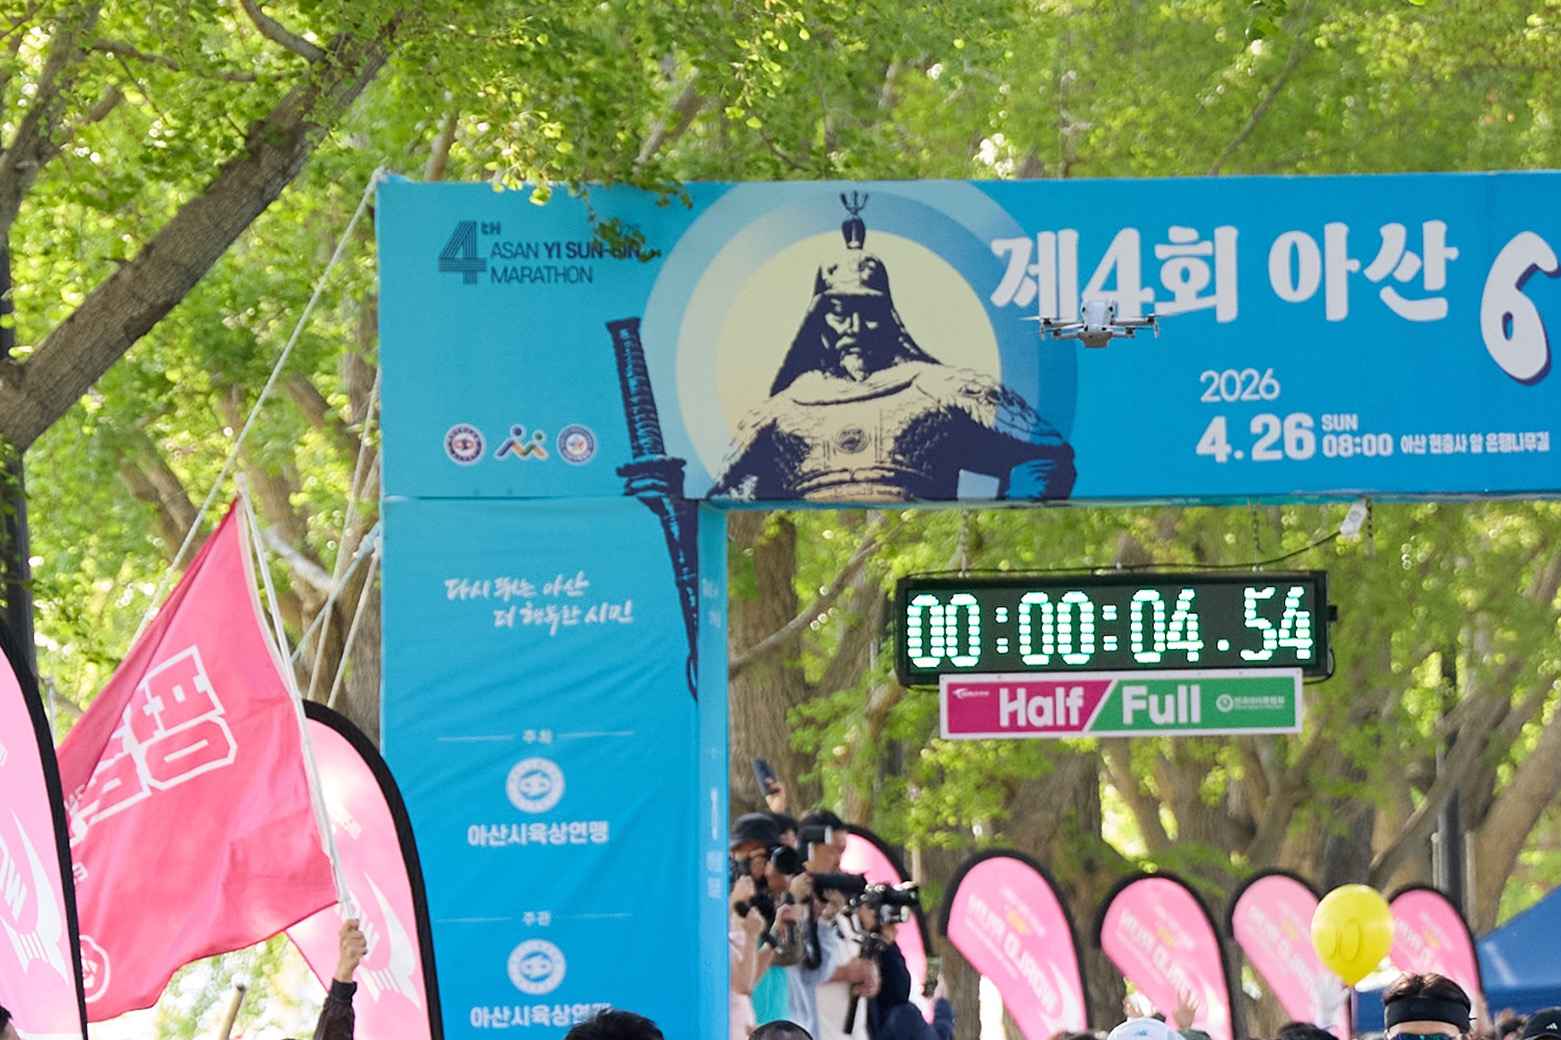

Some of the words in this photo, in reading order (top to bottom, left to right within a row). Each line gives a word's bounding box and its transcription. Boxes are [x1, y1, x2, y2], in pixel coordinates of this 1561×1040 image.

[490, 241, 539, 260] ASAN
[544, 241, 561, 259] YI
[490, 265, 594, 285] MARATHON
[991, 224, 1240, 324] 제4회
[1268, 219, 1460, 322] 아산
[1200, 368, 1281, 402] 2026
[1321, 414, 1359, 432] SUN
[1195, 412, 1315, 463] 4.26
[1322, 433, 1393, 458] 08:00
[584, 600, 633, 624] 시민
[999, 687, 1085, 728] Half
[1121, 685, 1201, 726] Full
[467, 820, 609, 846] 아산시육상연맹
